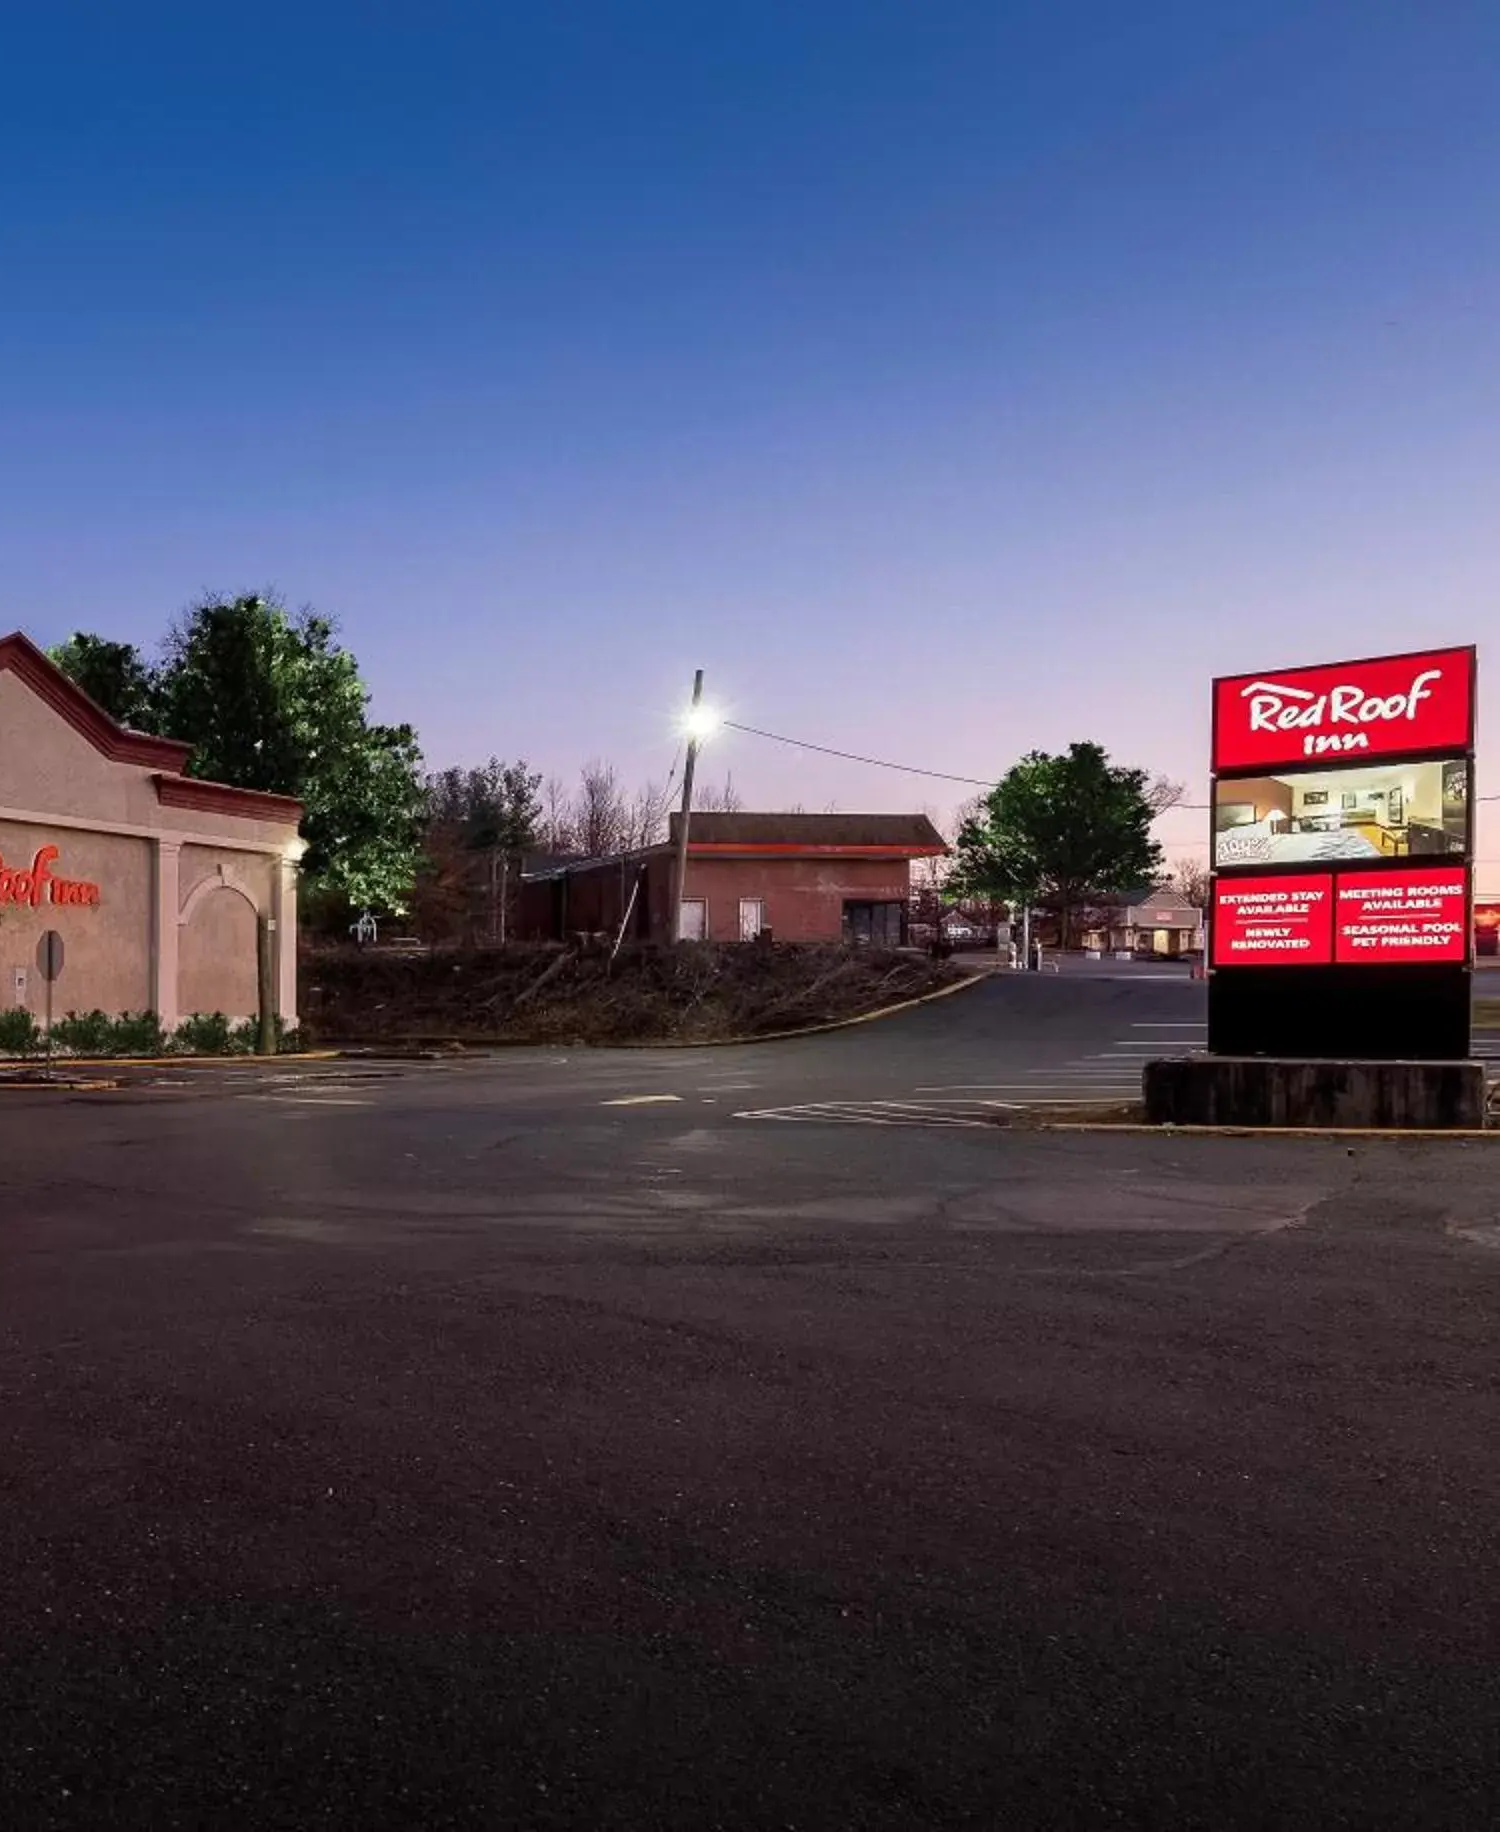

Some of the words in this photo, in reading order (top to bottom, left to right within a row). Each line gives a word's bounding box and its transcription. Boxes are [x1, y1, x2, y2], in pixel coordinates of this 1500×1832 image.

[1250, 695, 1327, 732] Red
[1331, 669, 1443, 724] Roof
[1220, 893, 1289, 905] EXTENDED
[1291, 891, 1324, 902] STAY
[1339, 887, 1403, 899] MEETING
[1407, 885, 1463, 896] ROOMS
[1236, 904, 1309, 915] AVAILABLE
[1362, 898, 1443, 911] AVAILABLE
[1245, 928, 1292, 938] NEWLY
[1342, 924, 1419, 936] SEASONAL
[1422, 923, 1463, 933] POOL
[1231, 938, 1311, 950] RENOVATED
[1351, 937, 1378, 947] PET
[1381, 935, 1451, 946] FRIENDLY
